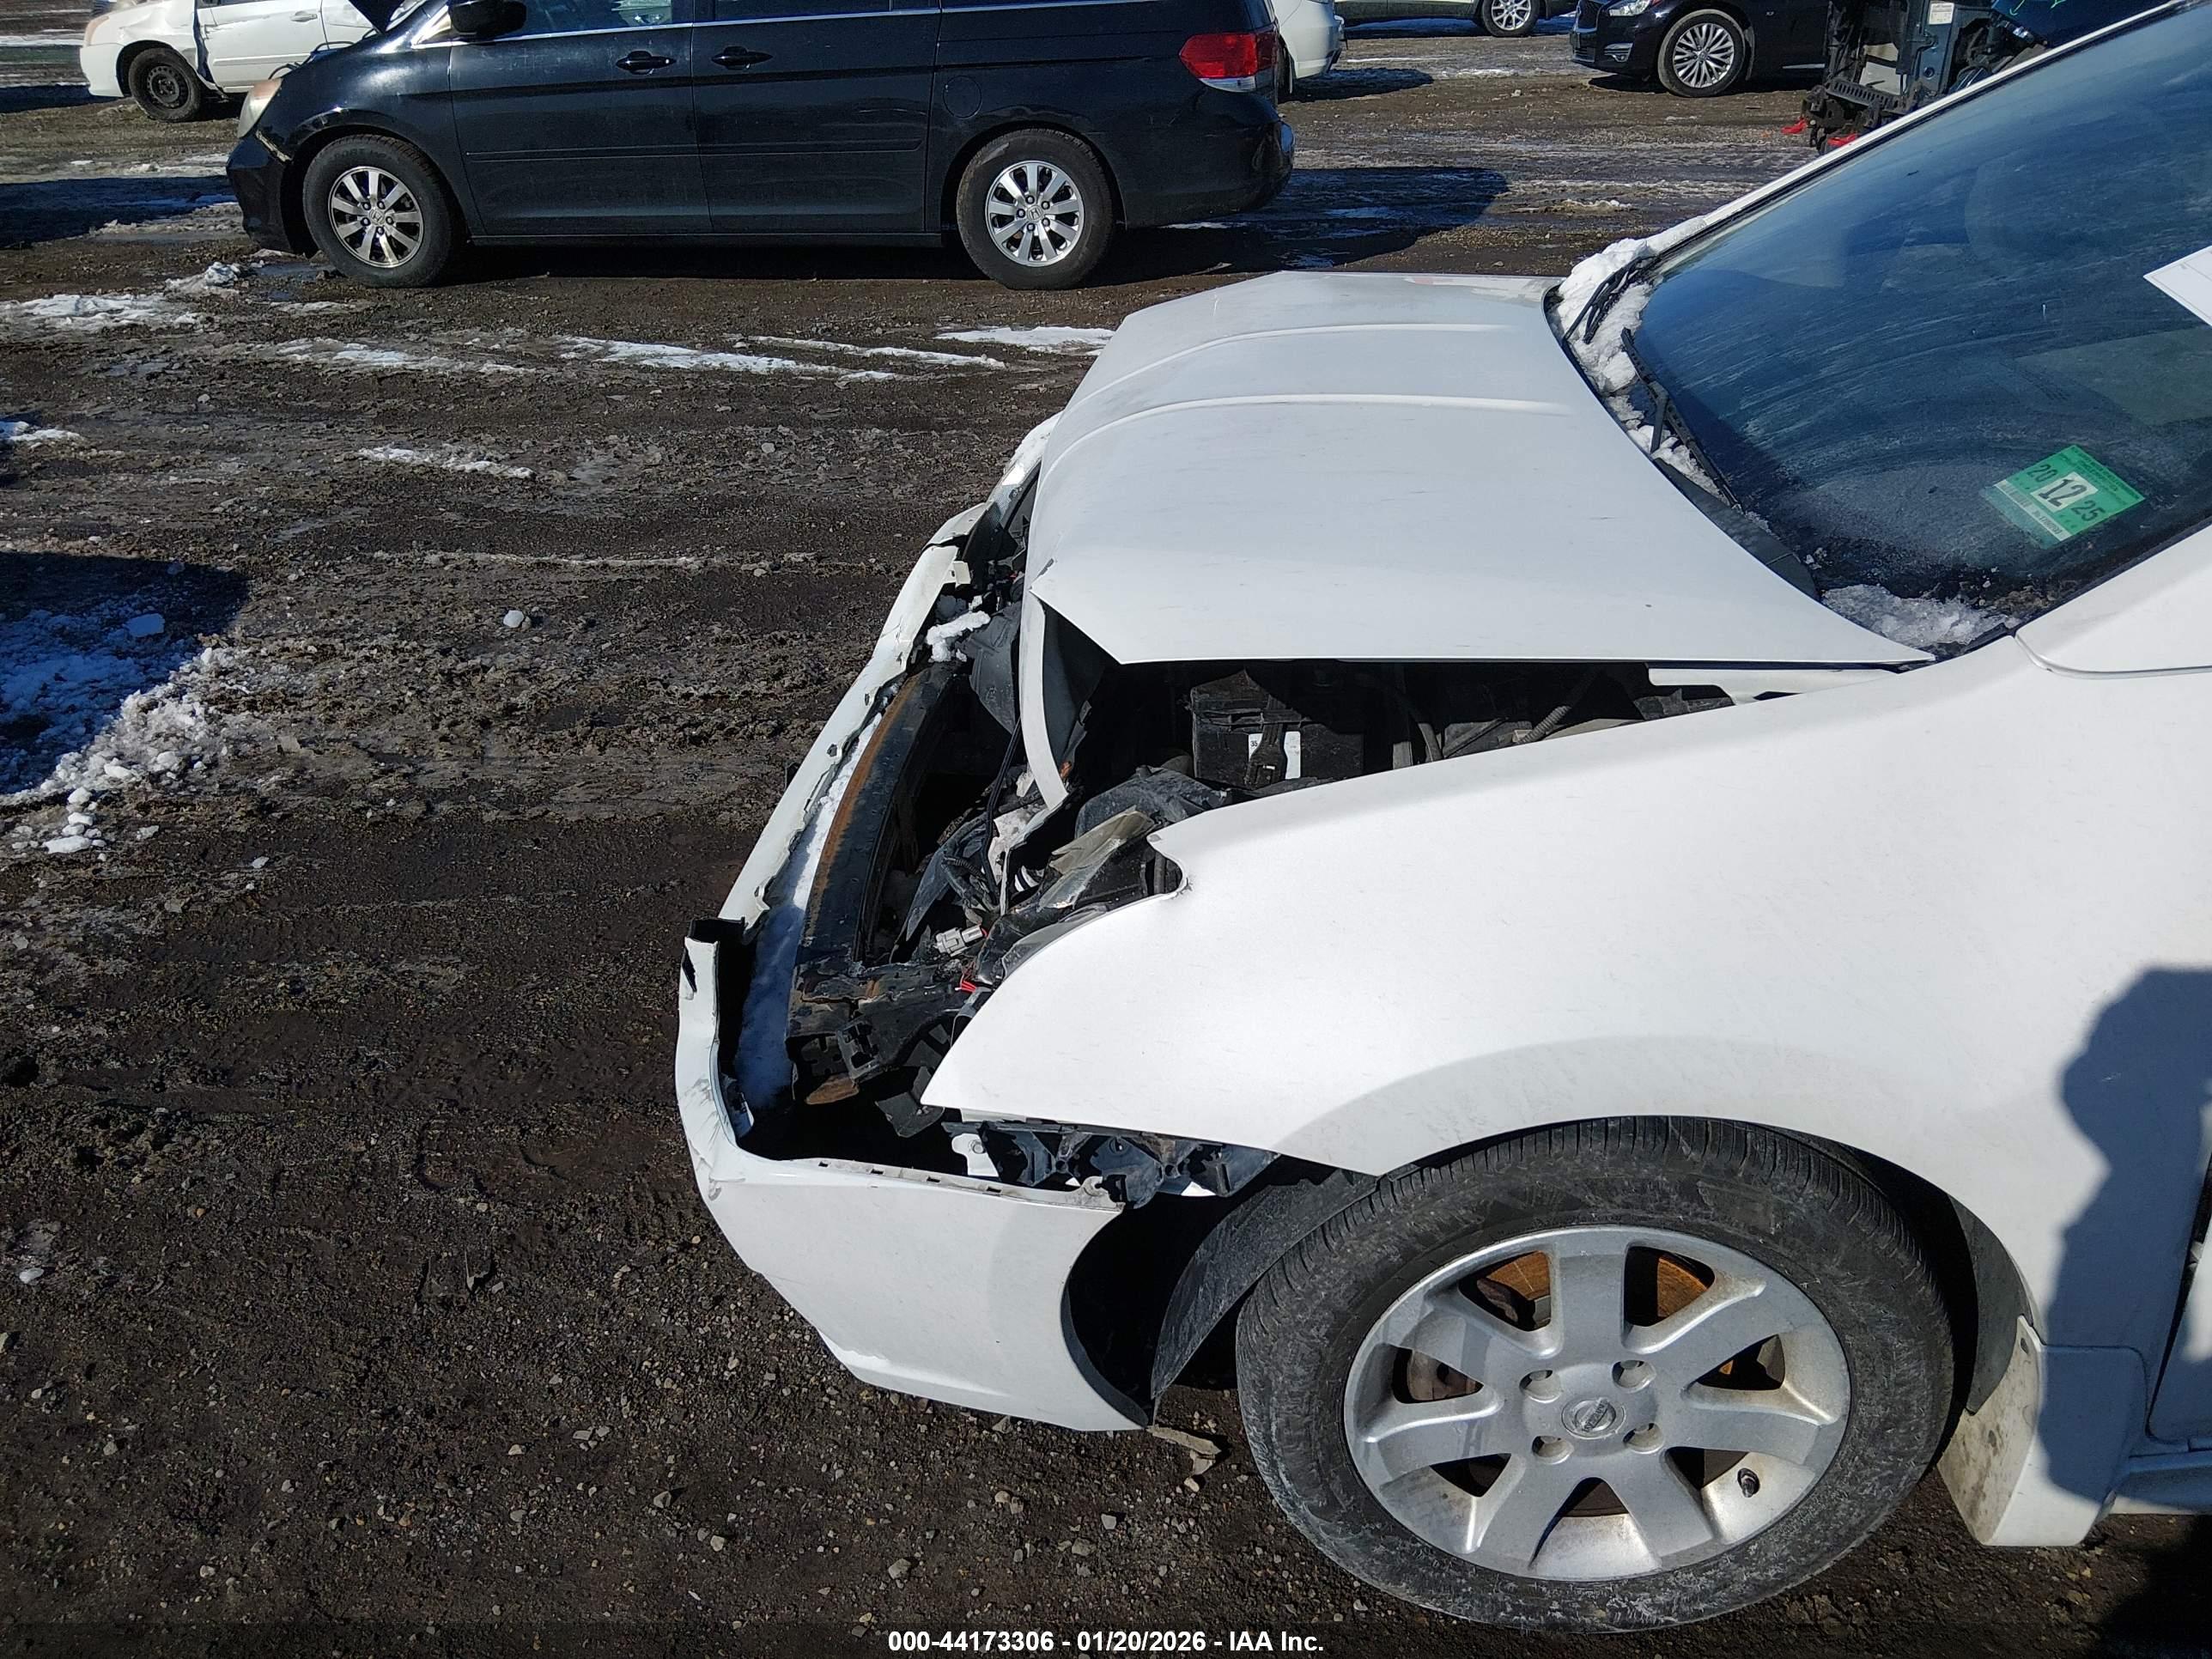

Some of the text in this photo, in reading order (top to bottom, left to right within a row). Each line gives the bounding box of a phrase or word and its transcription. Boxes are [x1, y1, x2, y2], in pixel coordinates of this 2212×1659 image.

[2027, 464, 2058, 483] 20
[2038, 478, 2087, 507] 12
[2071, 499, 2106, 521] 25
